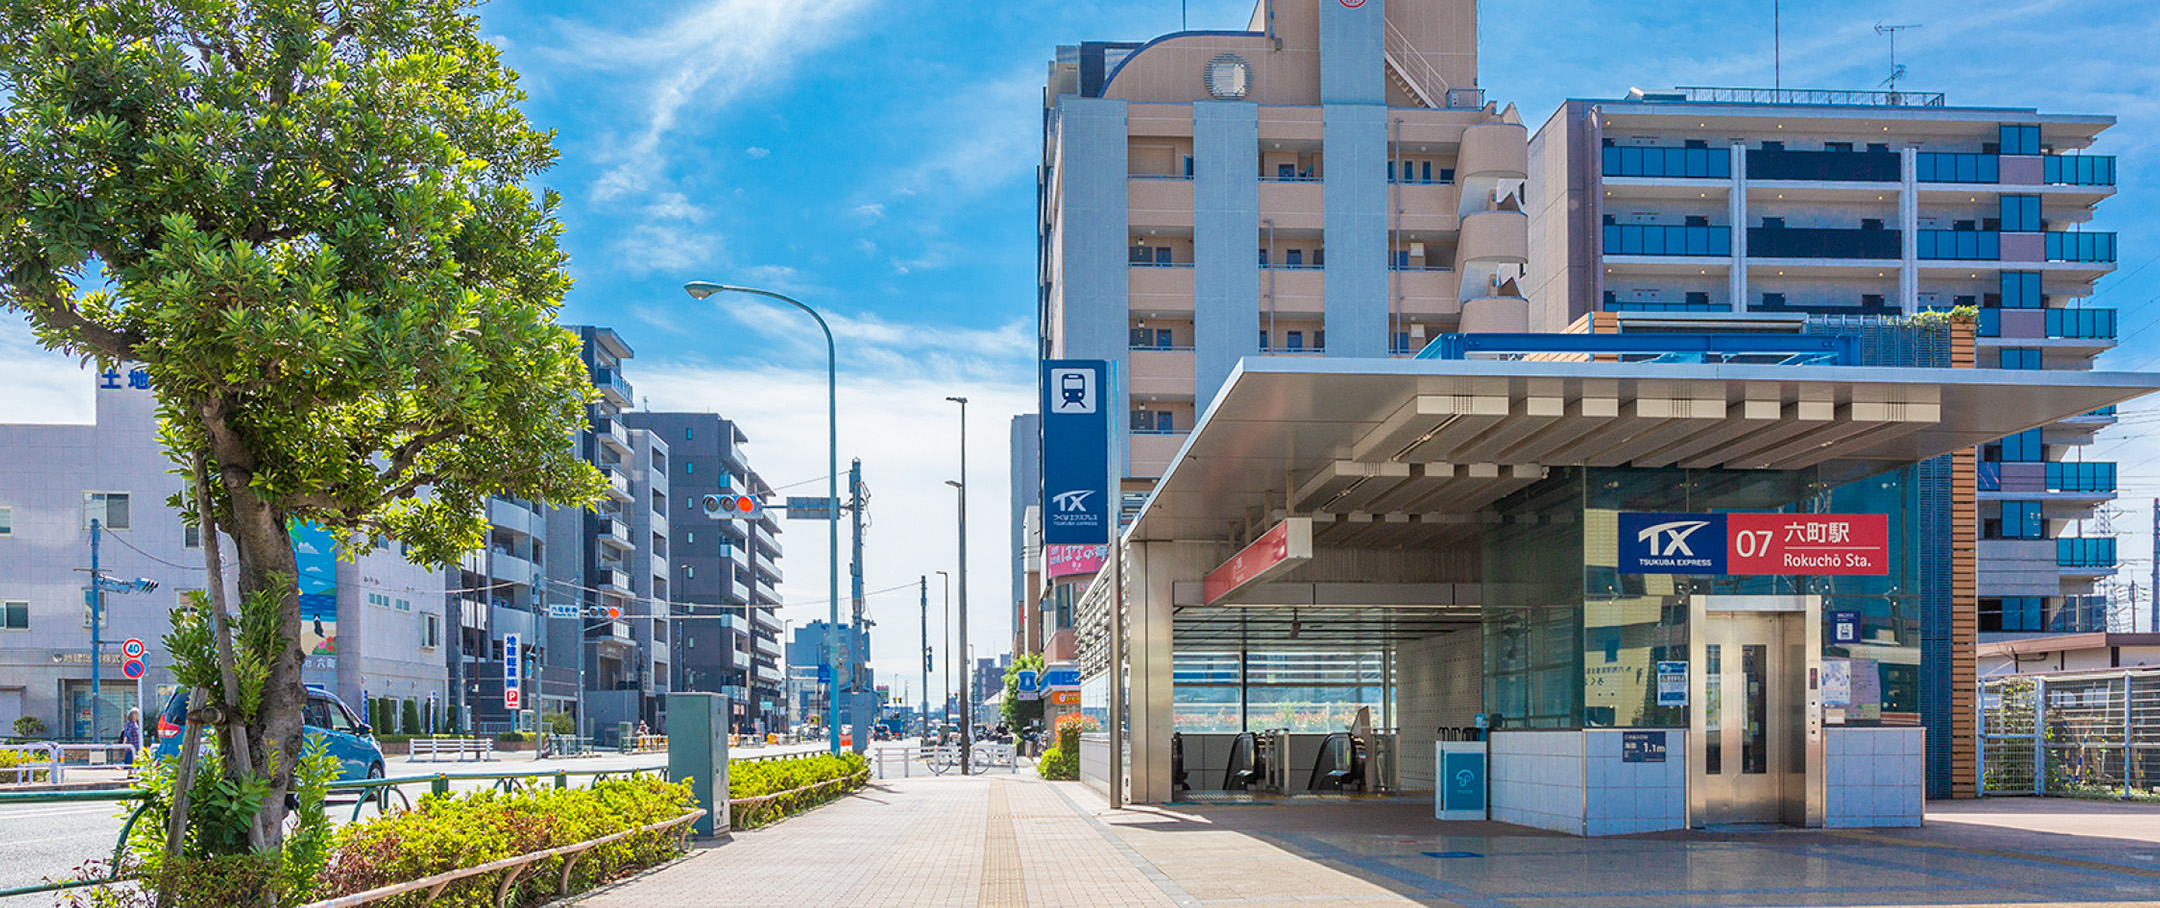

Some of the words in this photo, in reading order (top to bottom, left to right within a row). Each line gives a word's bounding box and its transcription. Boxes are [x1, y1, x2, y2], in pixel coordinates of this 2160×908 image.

[1052, 490, 1096, 512] TX
[1638, 520, 1711, 556] TX
[1784, 521, 1850, 543] 六町駅
[1736, 530, 1774, 558] 07
[1639, 558, 1676, 567] TSUKUBA
[1676, 558, 1712, 567] EXPRESS
[1784, 553, 1842, 567] Rokuchō
[1846, 553, 1872, 567] Sta.
[127, 643, 140, 654] 40
[508, 692, 516, 701] P
[1643, 742, 1666, 753] 1.1m
